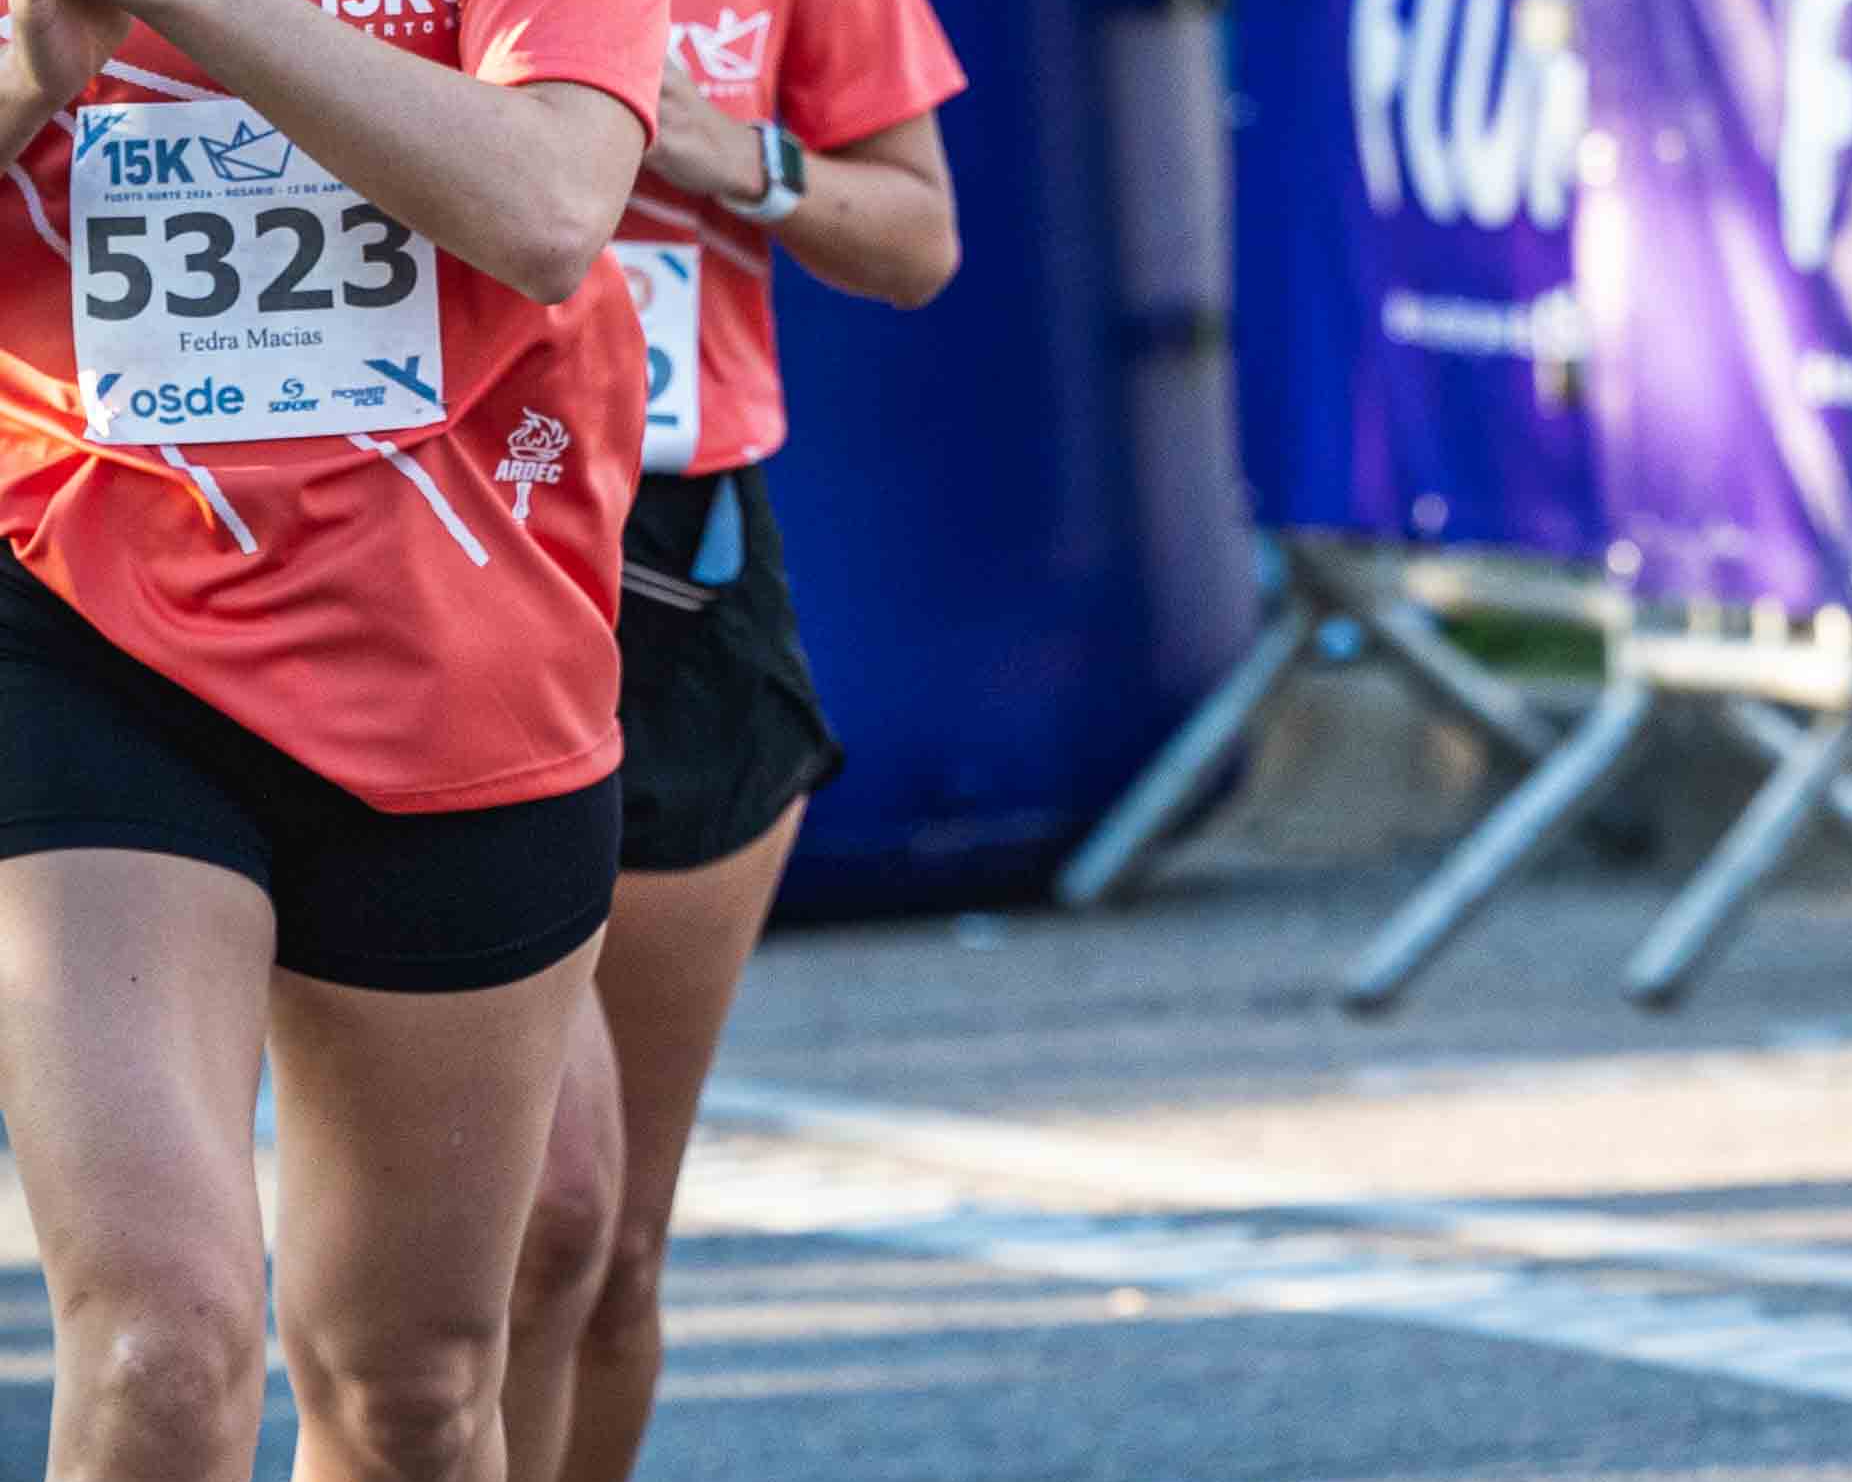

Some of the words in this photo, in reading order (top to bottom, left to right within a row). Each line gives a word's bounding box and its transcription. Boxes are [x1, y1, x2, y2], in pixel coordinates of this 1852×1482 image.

[364, 21, 434, 37] ERTO
[102, 136, 195, 186] 15K
[86, 204, 418, 321] 5323
[179, 331, 239, 352] Fedra
[247, 327, 323, 348] Macias
[494, 459, 564, 485] ARDEC
